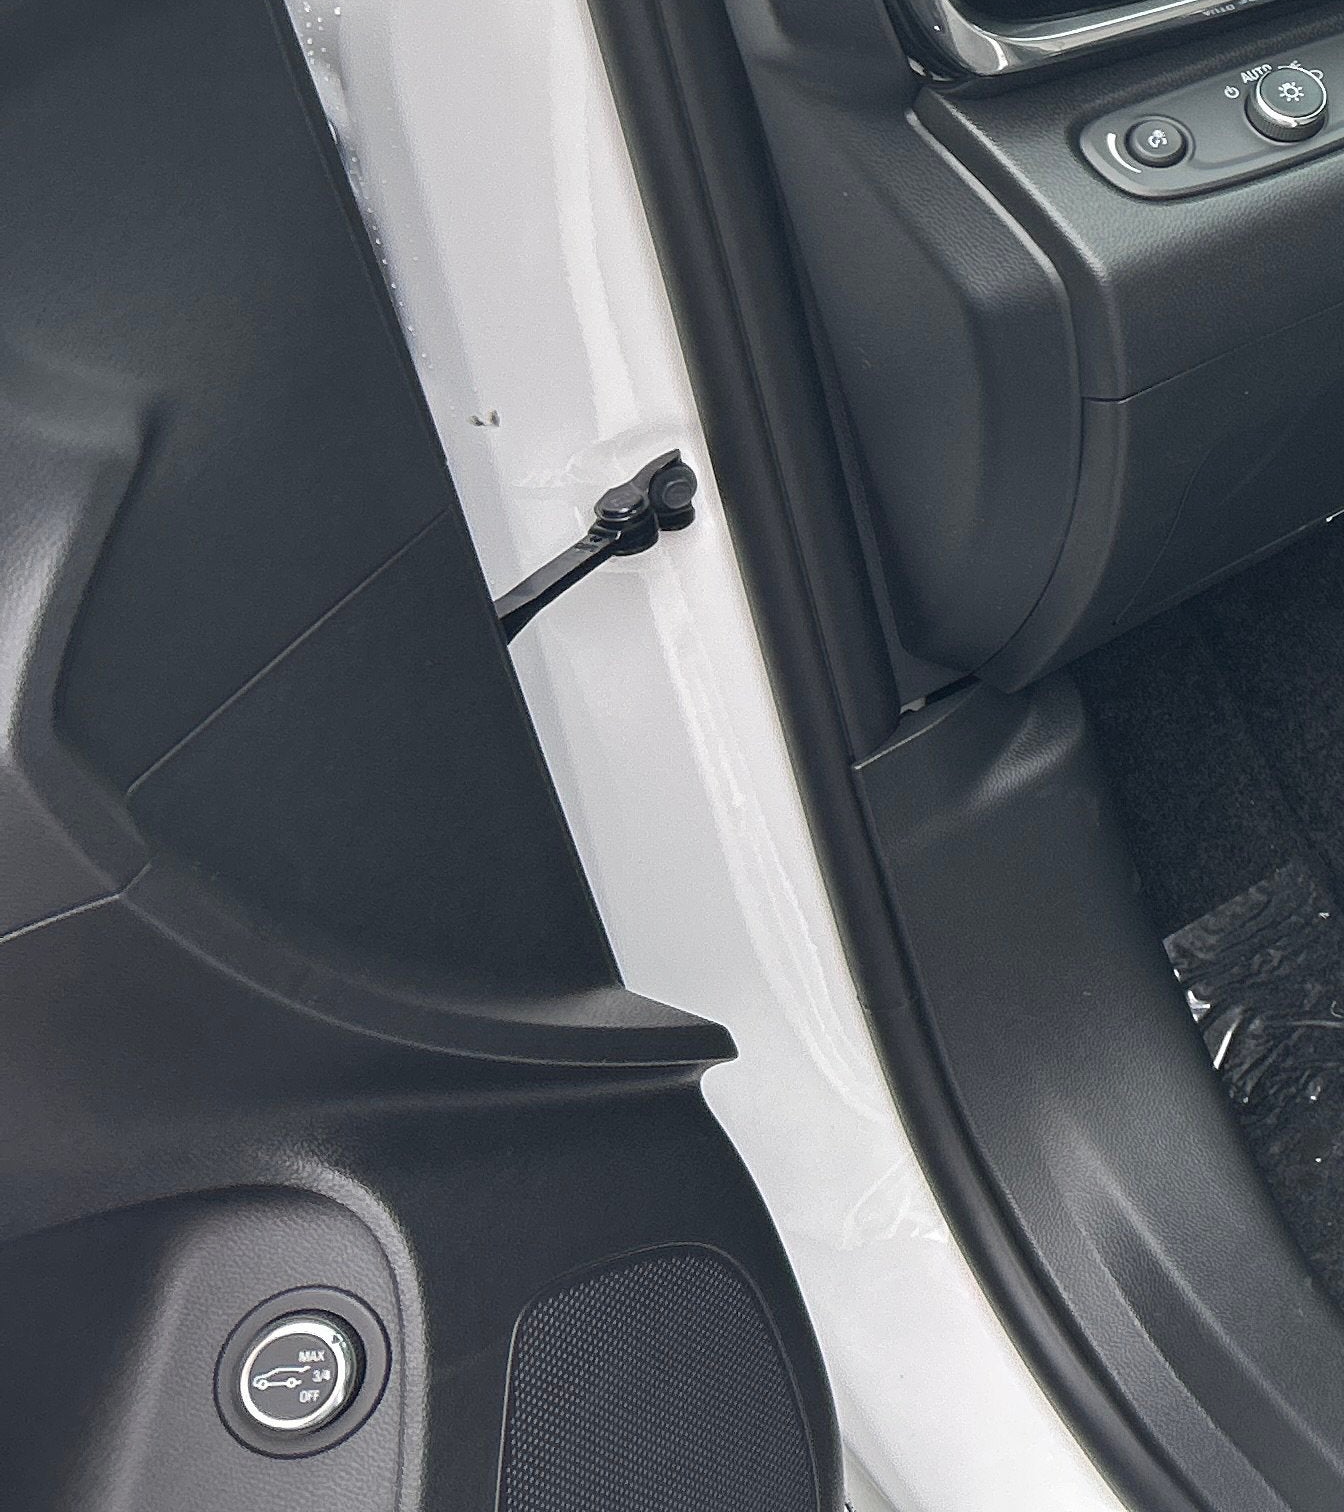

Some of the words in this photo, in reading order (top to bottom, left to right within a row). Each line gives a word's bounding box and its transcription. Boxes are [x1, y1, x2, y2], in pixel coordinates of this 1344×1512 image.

[1240, 63, 1273, 84] AUTO
[298, 1350, 326, 1363] MAX
[299, 1389, 321, 1403] OFF
